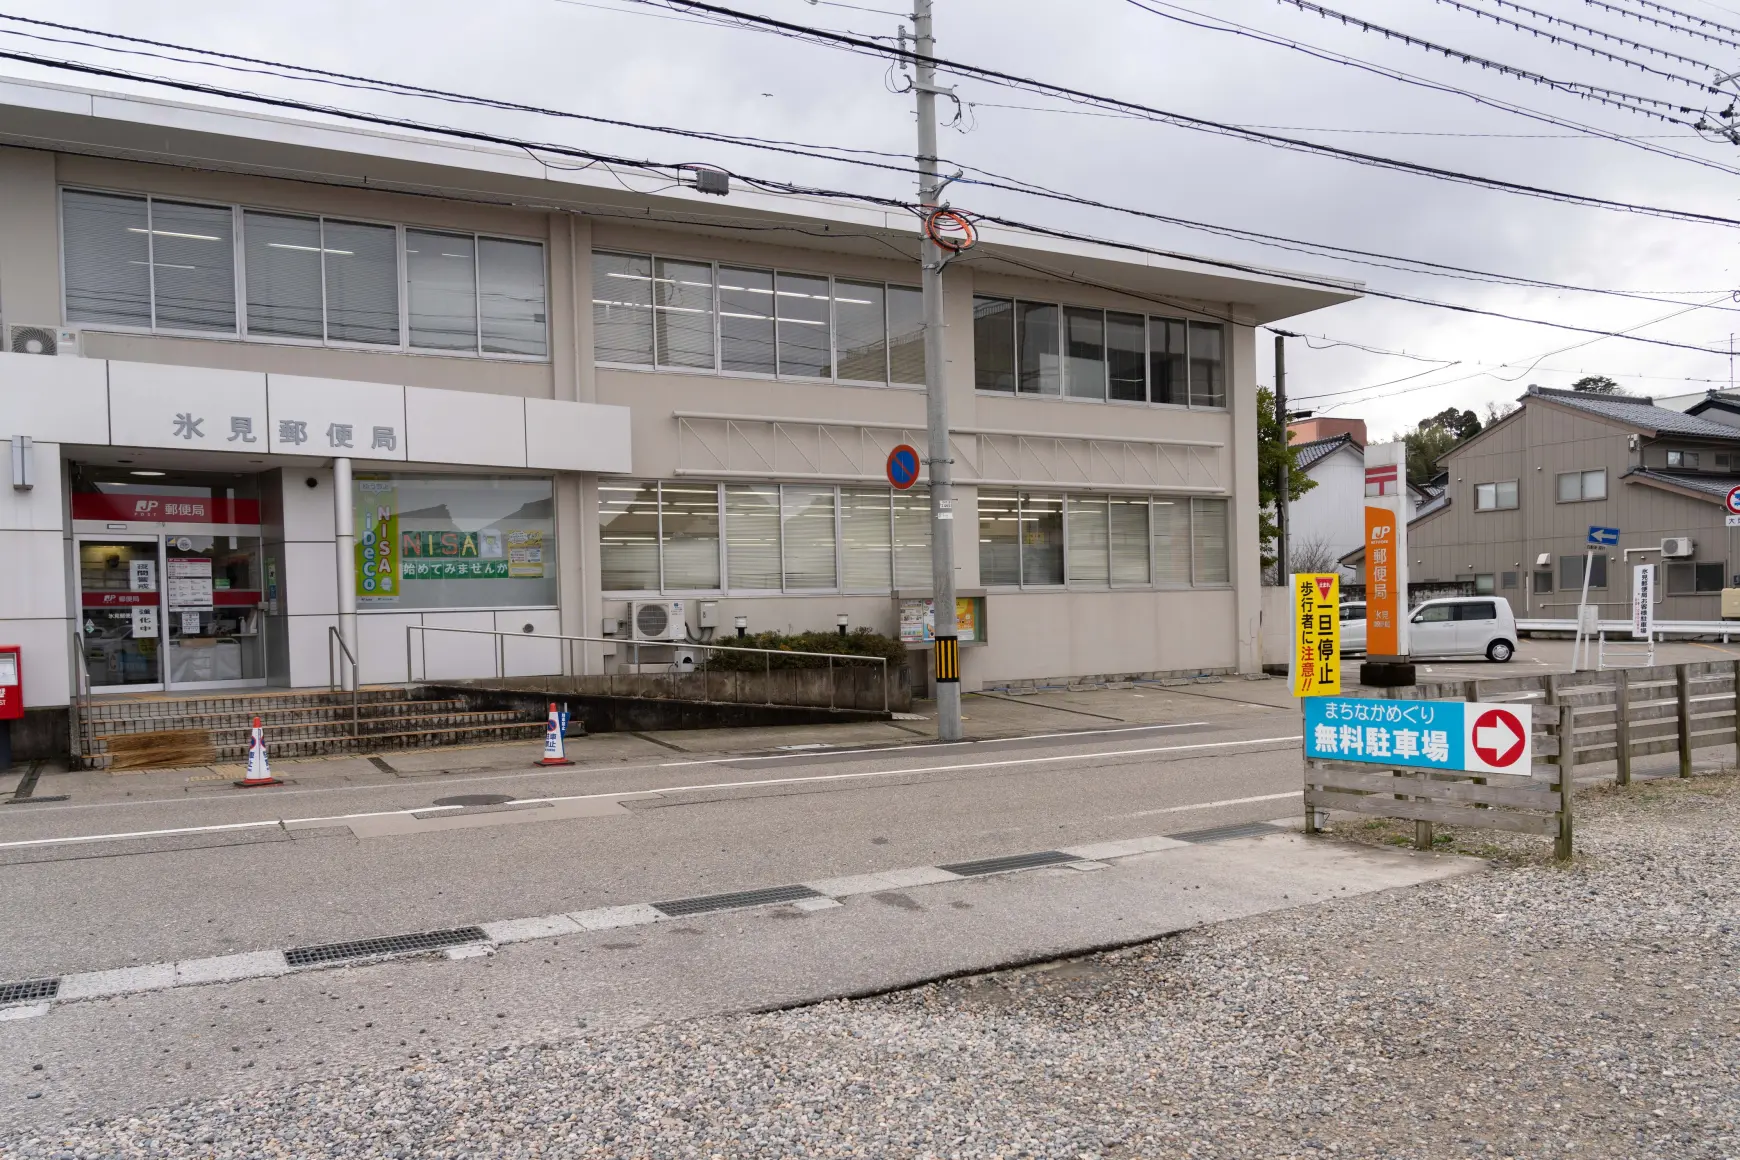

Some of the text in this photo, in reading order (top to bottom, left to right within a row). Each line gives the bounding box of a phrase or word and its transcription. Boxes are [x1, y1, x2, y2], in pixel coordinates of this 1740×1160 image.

[172, 412, 397, 451] 氷見郵便局
[165, 503, 205, 517] 郵便局
[362, 512, 376, 591] iDeCo
[377, 505, 392, 574] NISA
[403, 533, 478, 556] NISA
[403, 563, 508, 575] 始めてみませんか
[1373, 548, 1387, 600] 郵便局
[1317, 604, 1334, 685] 一旦停止
[1325, 702, 1434, 724] まちなかめぐり
[1314, 722, 1449, 762] 無料駐車場
